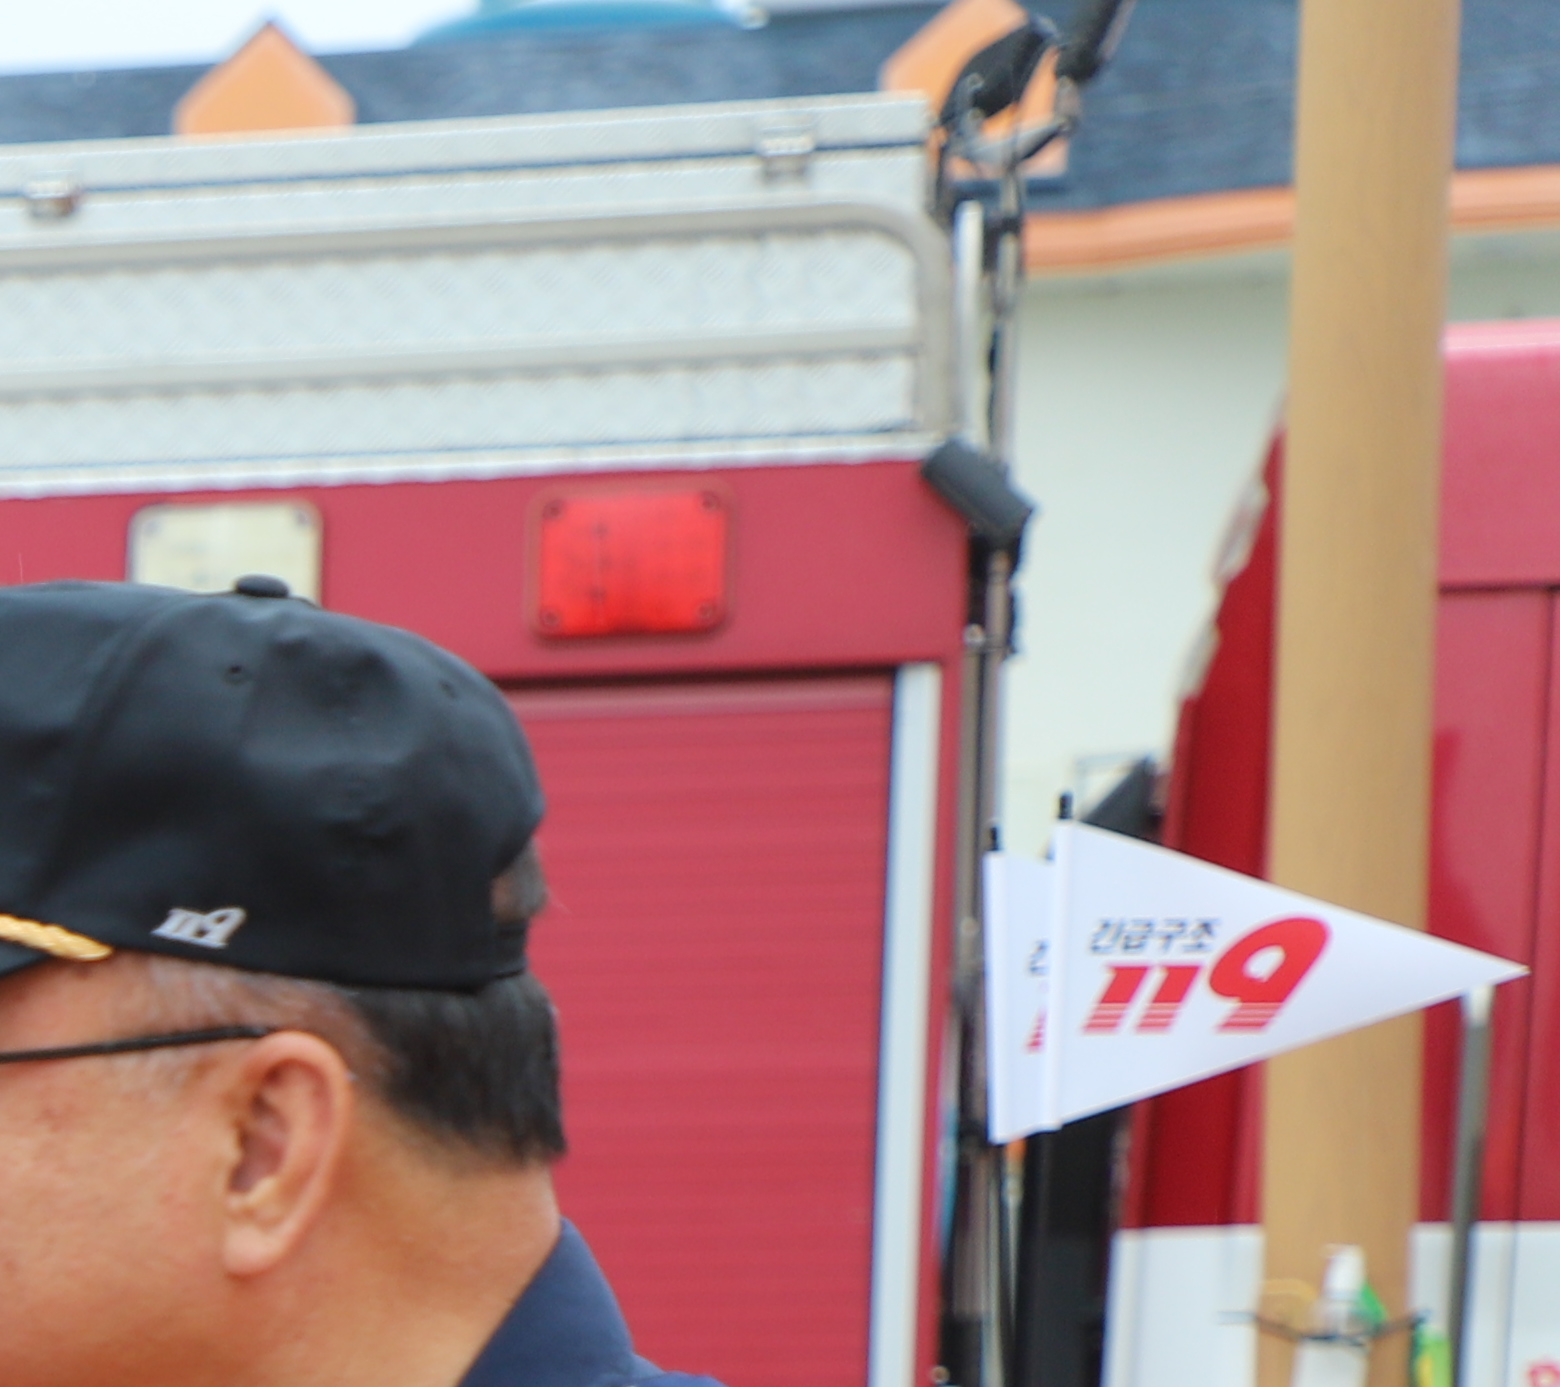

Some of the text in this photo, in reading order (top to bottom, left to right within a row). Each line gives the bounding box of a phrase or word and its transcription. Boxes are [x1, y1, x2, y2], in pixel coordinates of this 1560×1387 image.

[150, 907, 246, 949] 119
[1089, 917, 1219, 955] 긴급구조
[1081, 915, 1331, 1034] 119
